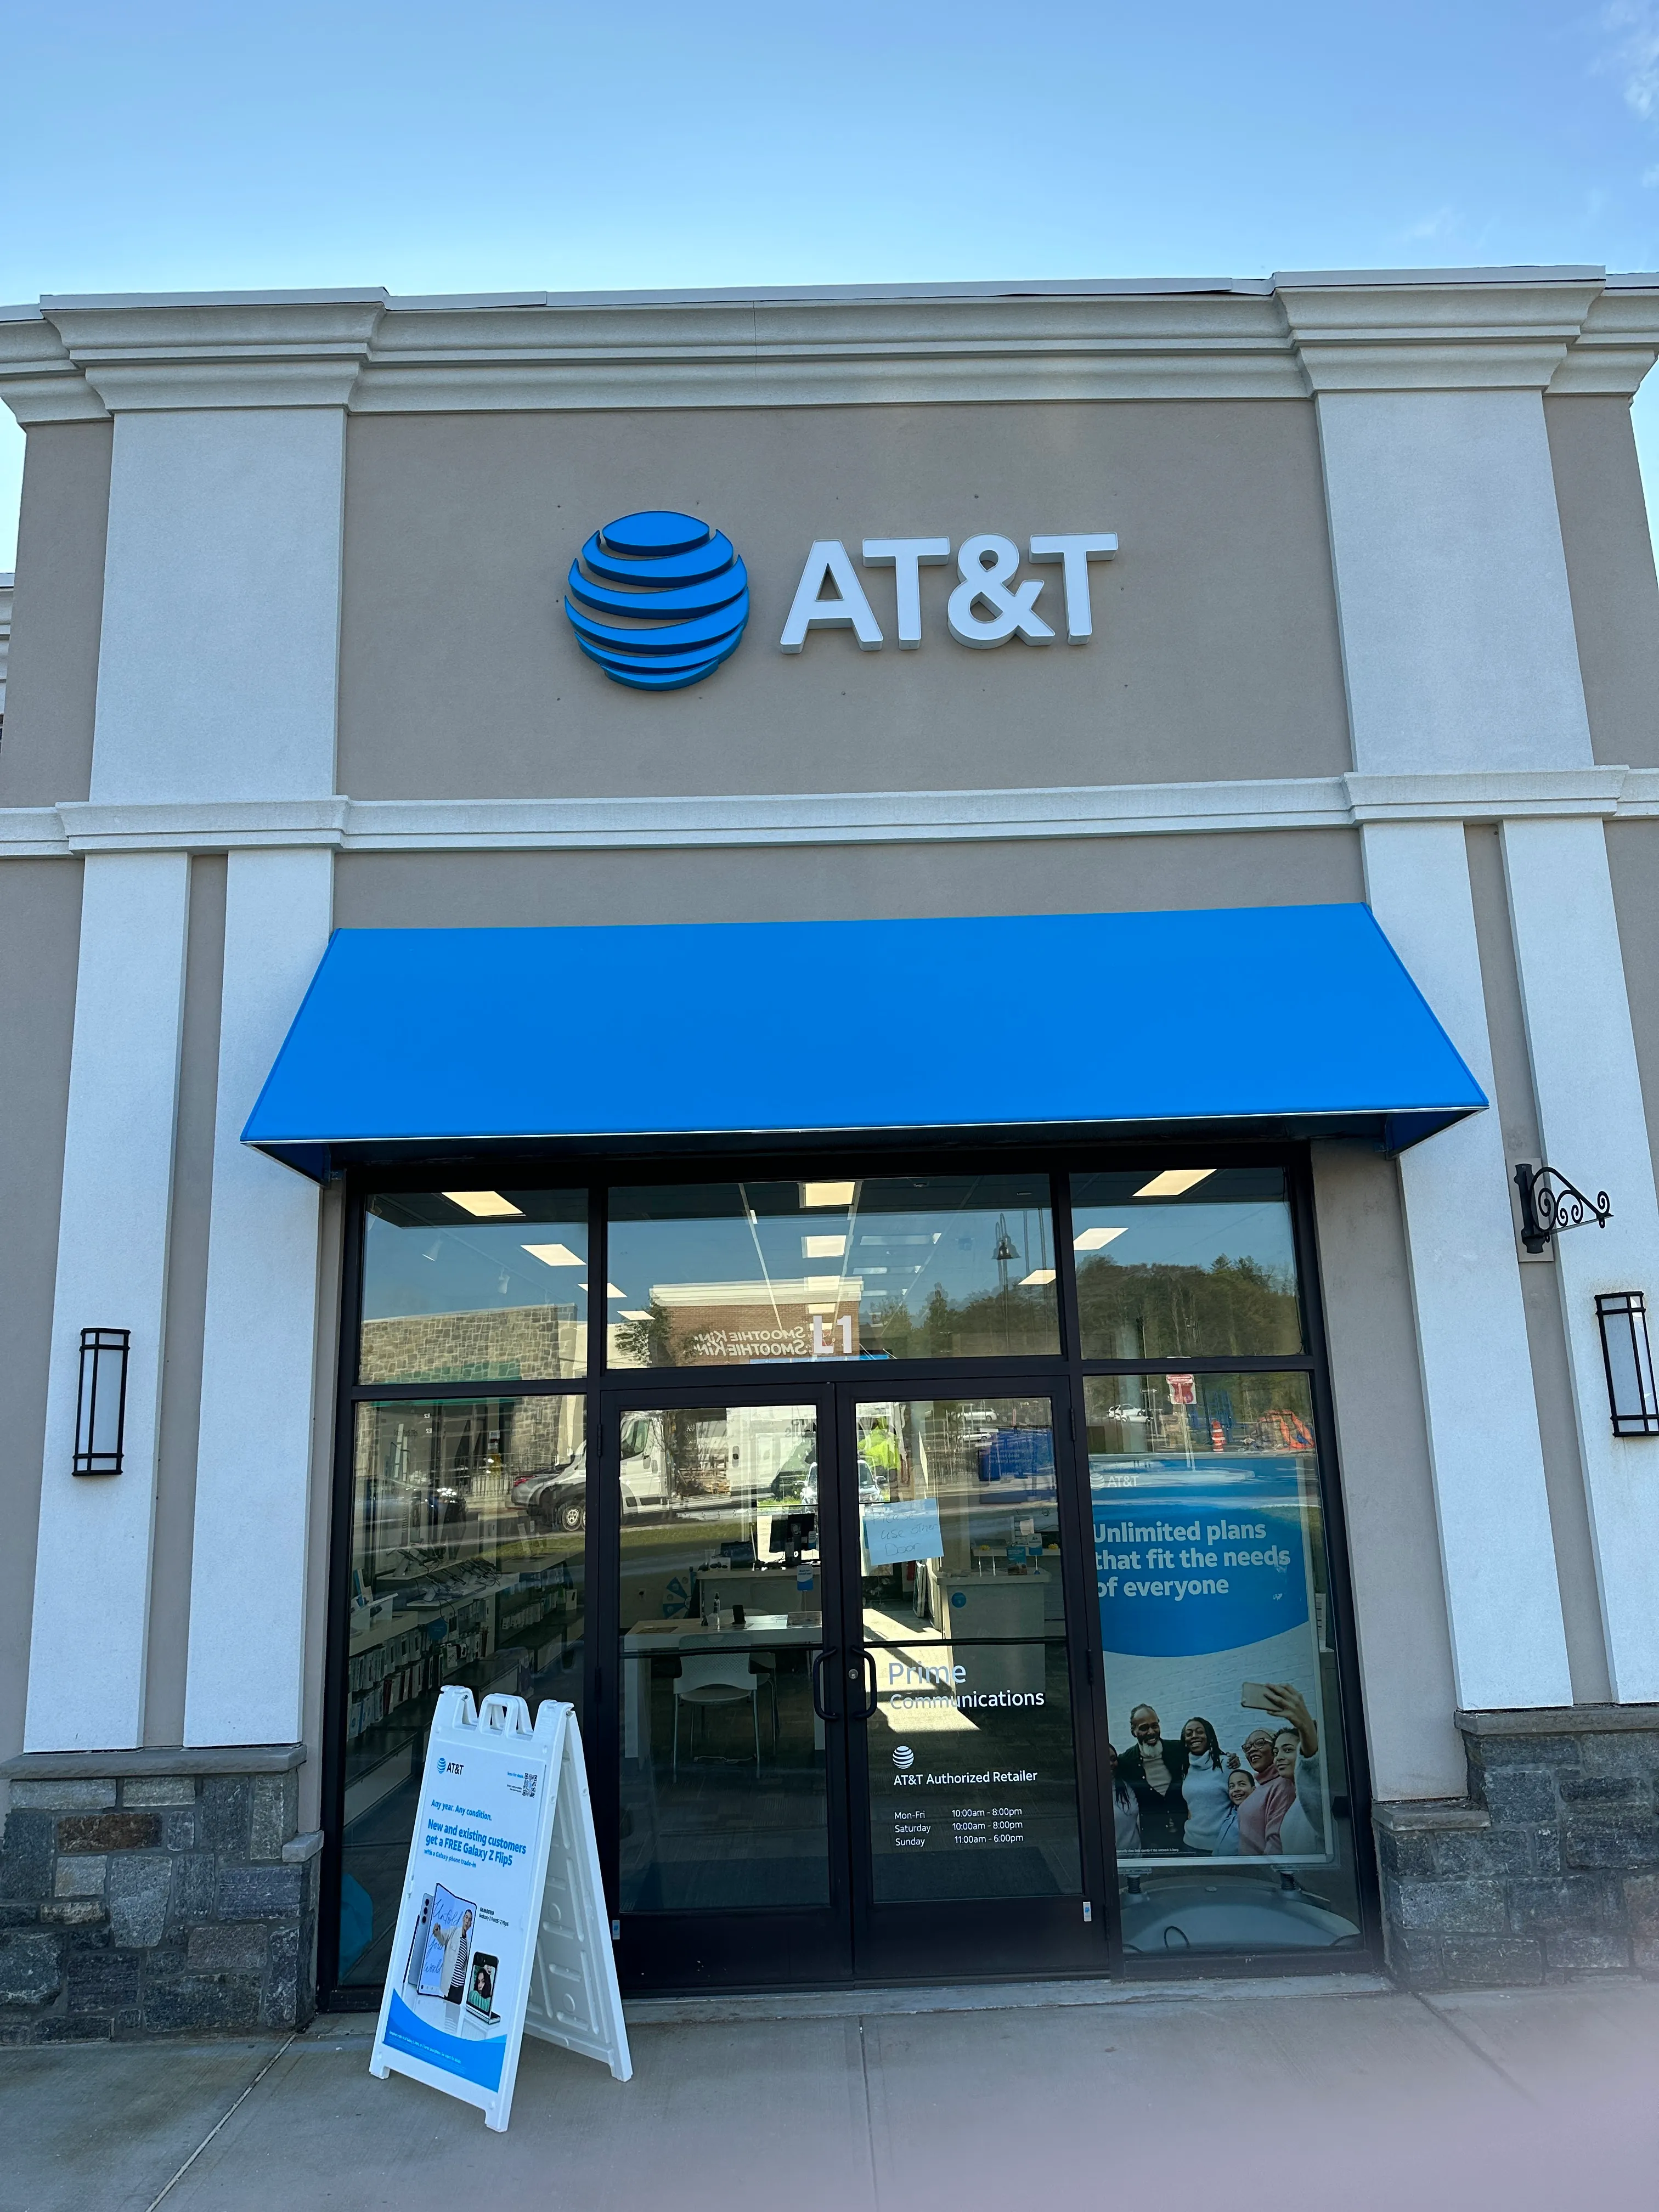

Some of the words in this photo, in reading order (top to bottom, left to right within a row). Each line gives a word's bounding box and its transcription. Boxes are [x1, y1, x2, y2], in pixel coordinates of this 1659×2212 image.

[780, 532, 1119, 654] AT&T
[813, 1315, 852, 1354] L1
[1107, 1475, 1139, 1488] AT&T
[1093, 1520, 1200, 1543] Unlimited
[1207, 1519, 1267, 1545] plans
[885, 1543, 921, 1556] Door
[1096, 1550, 1142, 1570] that
[1146, 1548, 1175, 1570] fit
[1180, 1547, 1218, 1568] the
[1223, 1545, 1291, 1567] needs
[1098, 1576, 1119, 1598] of
[1124, 1578, 1229, 1601] everyone
[888, 1660, 967, 1685] Prime
[889, 1689, 1045, 1711] Communications
[446, 1762, 464, 1775] AT&T
[893, 1773, 923, 1786] AT&T
[926, 1771, 990, 1785] Authorized
[992, 1770, 1038, 1782] Retailer
[431, 1799, 442, 1810] Any
[442, 1802, 454, 1812] year.
[455, 1804, 466, 1816] Any
[466, 1808, 492, 1821] condition.
[894, 1810, 926, 1820] Mon-Fri
[952, 1808, 985, 1818] 10:00am
[992, 1808, 1023, 1819] 8:00pm
[427, 1818, 444, 1832] New
[444, 1824, 458, 1836] and
[459, 1827, 487, 1847] existing
[488, 1836, 527, 1855] customers
[895, 1823, 932, 1833] Saturday
[952, 1821, 986, 1831] 10:00am
[992, 1820, 1023, 1831] 8:00pm
[425, 1834, 438, 1846] get
[438, 1838, 443, 1847] a
[444, 1837, 462, 1852] FREE
[463, 1843, 488, 1862] Galaxy
[488, 1849, 495, 1861] Z
[495, 1851, 513, 1867] Flip5
[895, 1837, 926, 1847] Sunday
[954, 1834, 987, 1844] 11:00am
[994, 1833, 1024, 1844] 6:00pm
